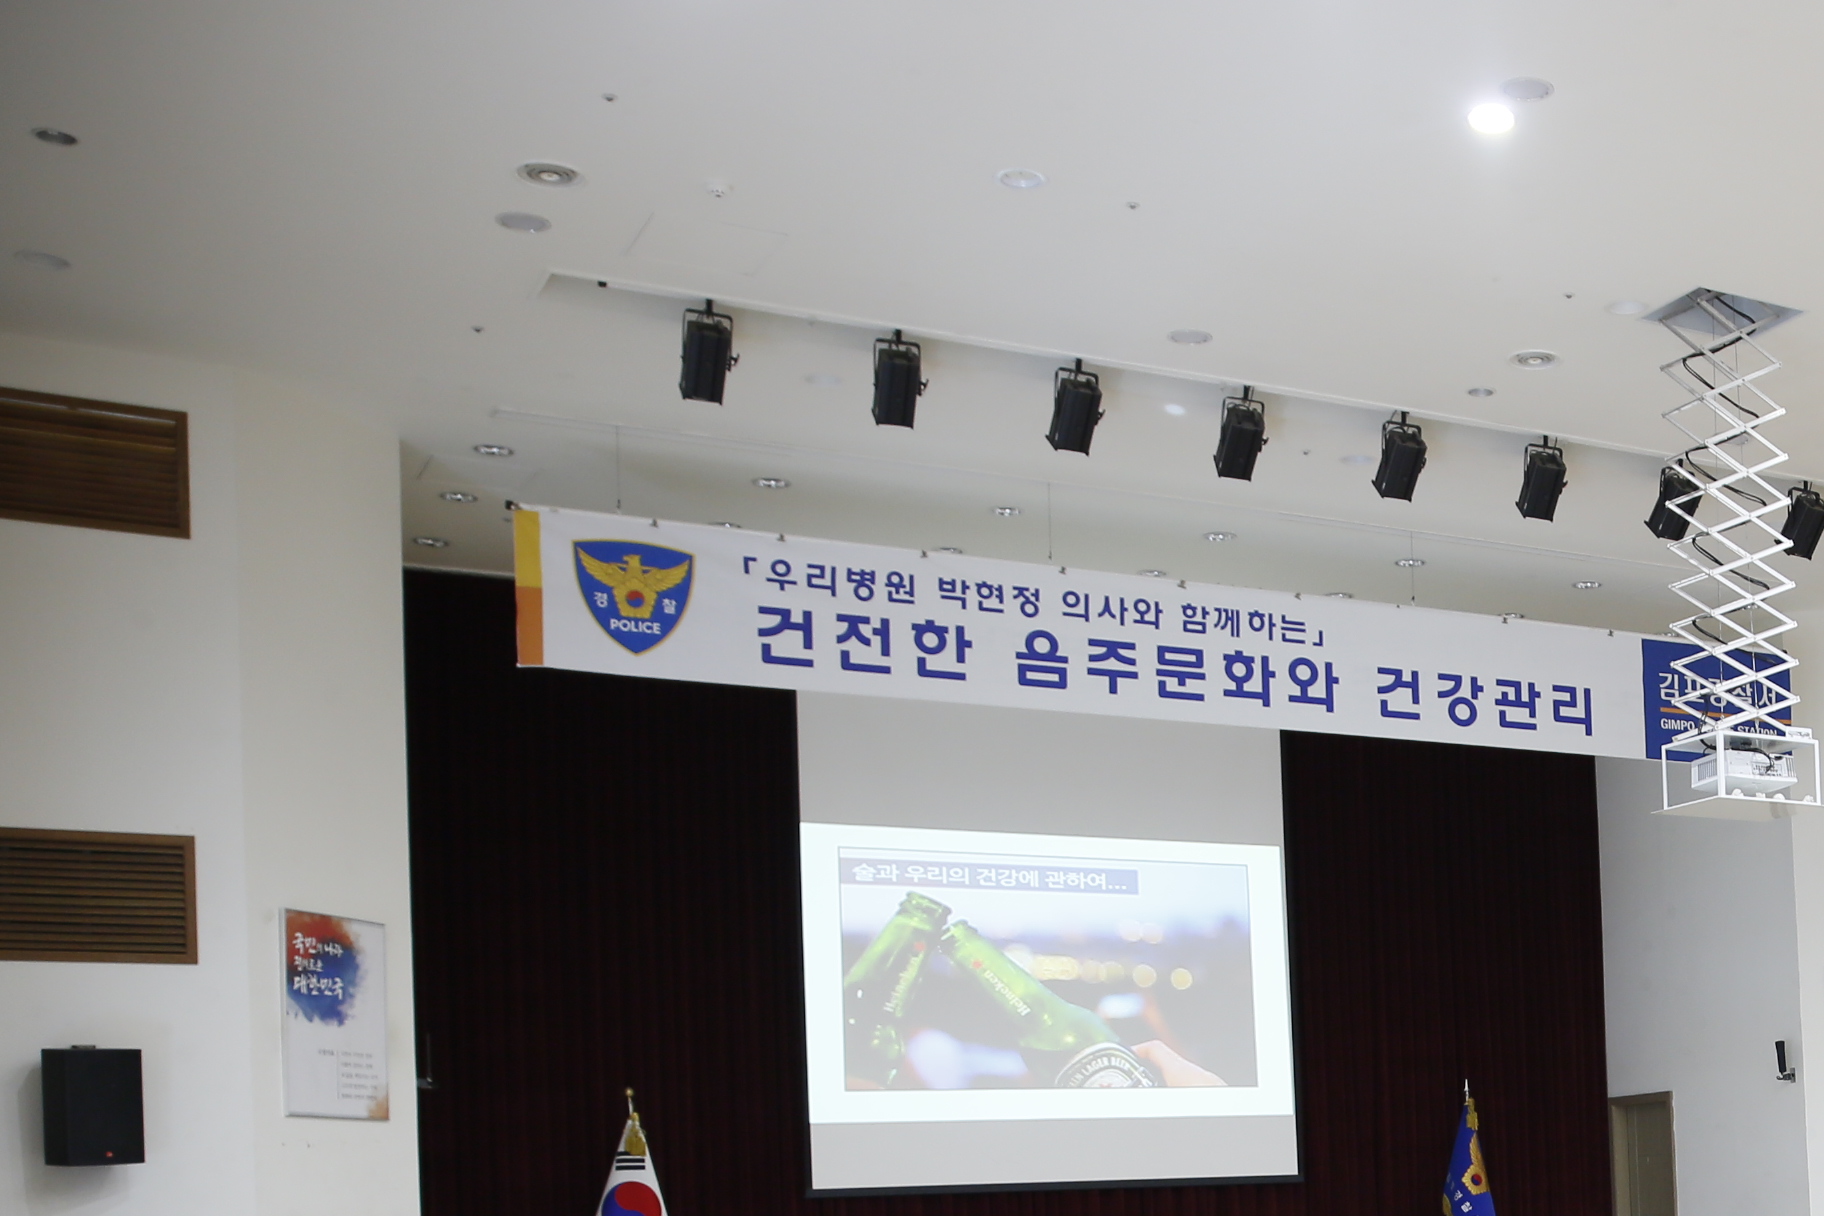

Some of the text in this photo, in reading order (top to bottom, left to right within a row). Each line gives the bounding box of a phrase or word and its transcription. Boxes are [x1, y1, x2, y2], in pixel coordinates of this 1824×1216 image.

[937, 576, 1040, 618] 박현정
[1061, 590, 1163, 630] 의사와
[609, 618, 662, 635] POLICE
[757, 604, 1593, 737] 건전한 음주문화와 건강관리
[1660, 718, 1696, 732] GIMPO
[852, 863, 1127, 890] 술과 우리의 건강에 관하여...
[293, 973, 344, 1000] 대한민국
